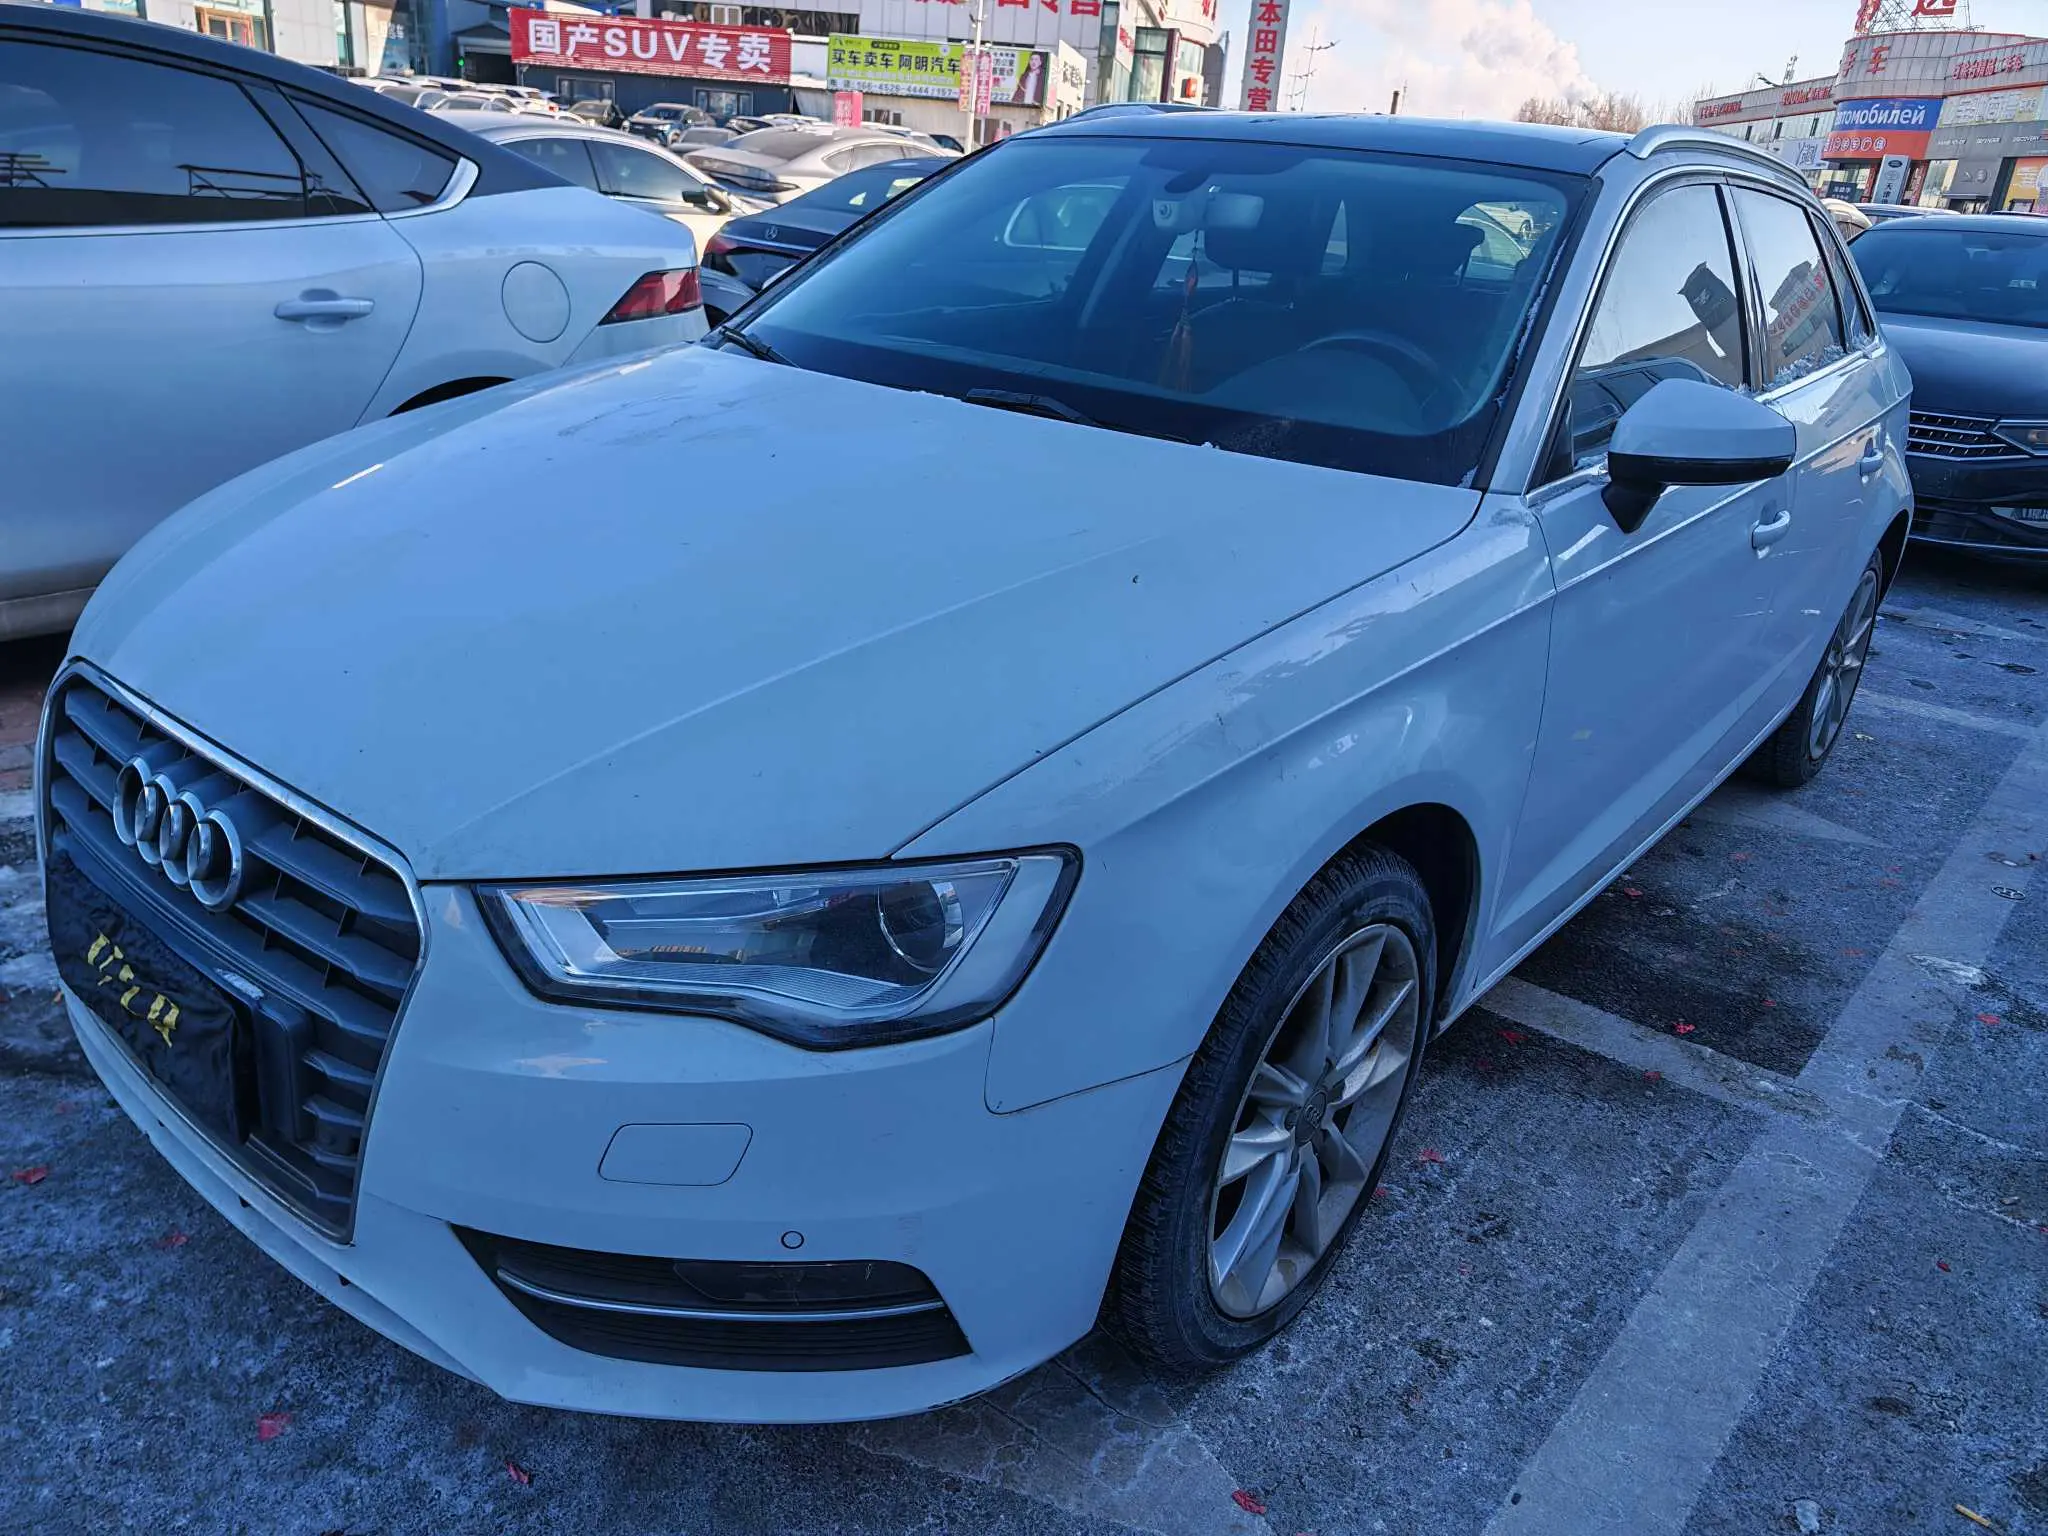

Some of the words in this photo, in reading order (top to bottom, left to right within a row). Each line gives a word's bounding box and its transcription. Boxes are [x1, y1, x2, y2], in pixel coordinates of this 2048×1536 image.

[528, 18, 772, 73] 国产SUV专卖
[832, 48, 893, 69] 买车卖车
[899, 54, 961, 75] 阿明汽车
[1247, 0, 1282, 112] 本田专营
